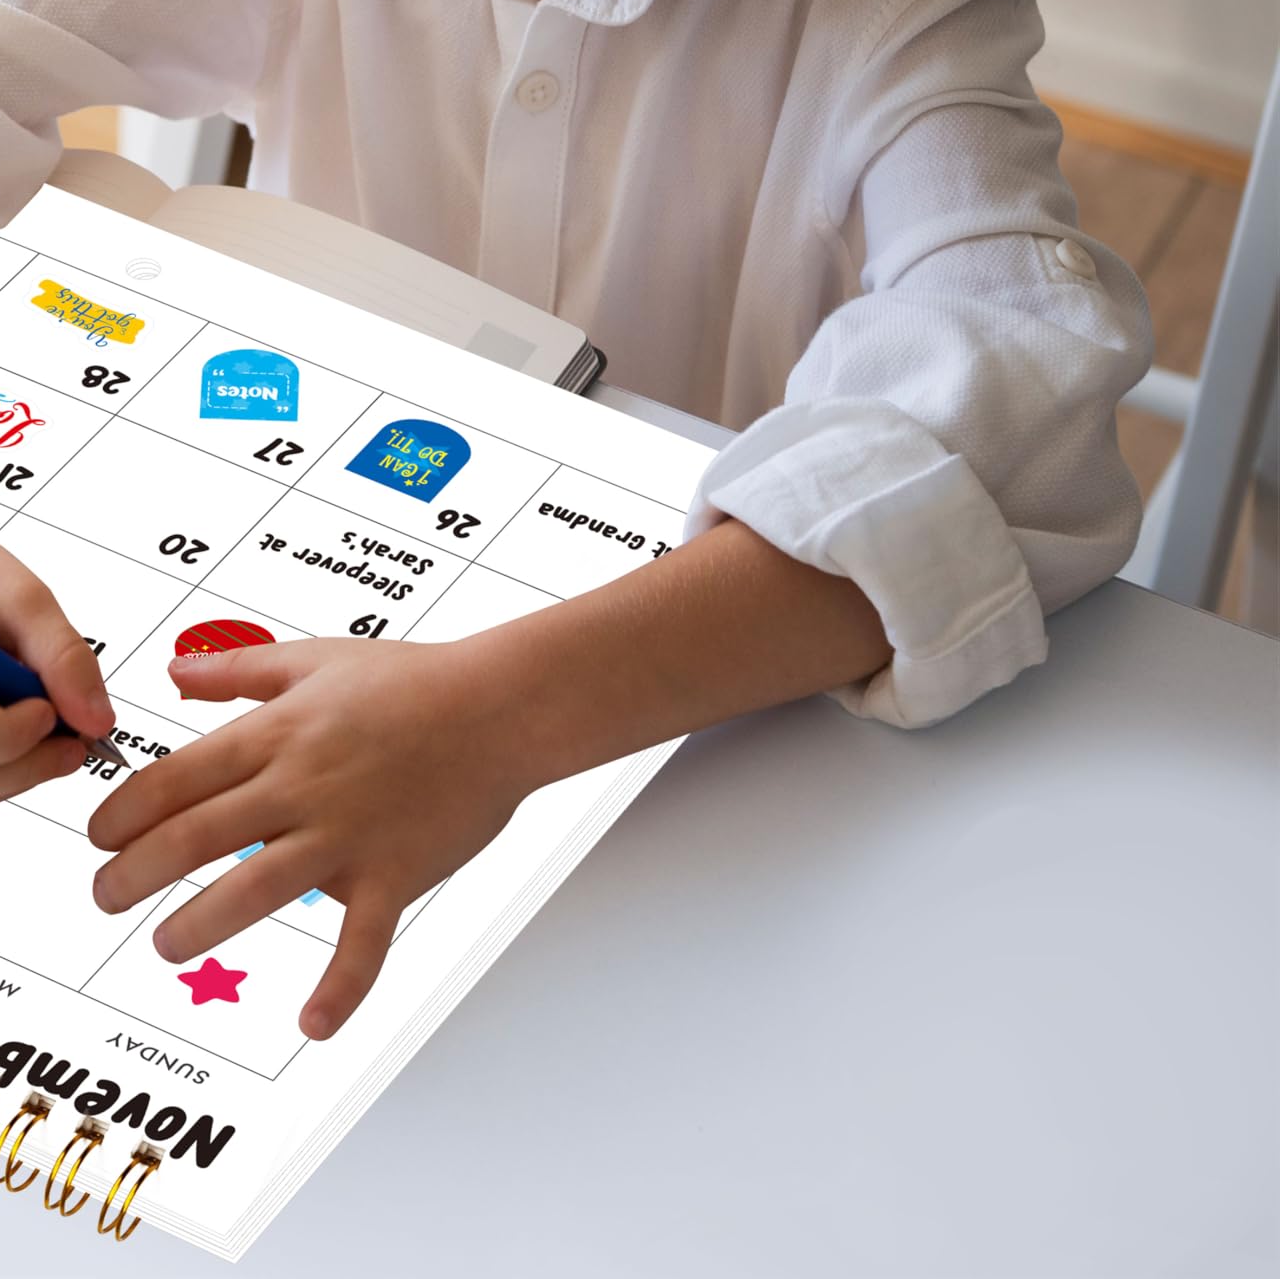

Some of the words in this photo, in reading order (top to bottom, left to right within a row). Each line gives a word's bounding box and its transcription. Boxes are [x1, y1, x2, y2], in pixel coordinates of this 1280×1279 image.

[55, 288, 95, 319] this
[47, 304, 108, 348] You've
[91, 309, 137, 329] got
[81, 364, 131, 395] 28
[217, 384, 278, 401] Notes
[252, 437, 305, 466] 27
[379, 454, 418, 477] CAN
[418, 446, 448, 467] DO
[417, 469, 432, 486] I
[435, 509, 481, 539] 26
[538, 502, 646, 550] Grandma
[158, 533, 210, 564] 20
[259, 532, 288, 554] at
[341, 530, 434, 576] Sarah's
[293, 547, 414, 602] Sleepover
[348, 613, 389, 639] 19
[105, 1032, 210, 1085] SUNDAY
